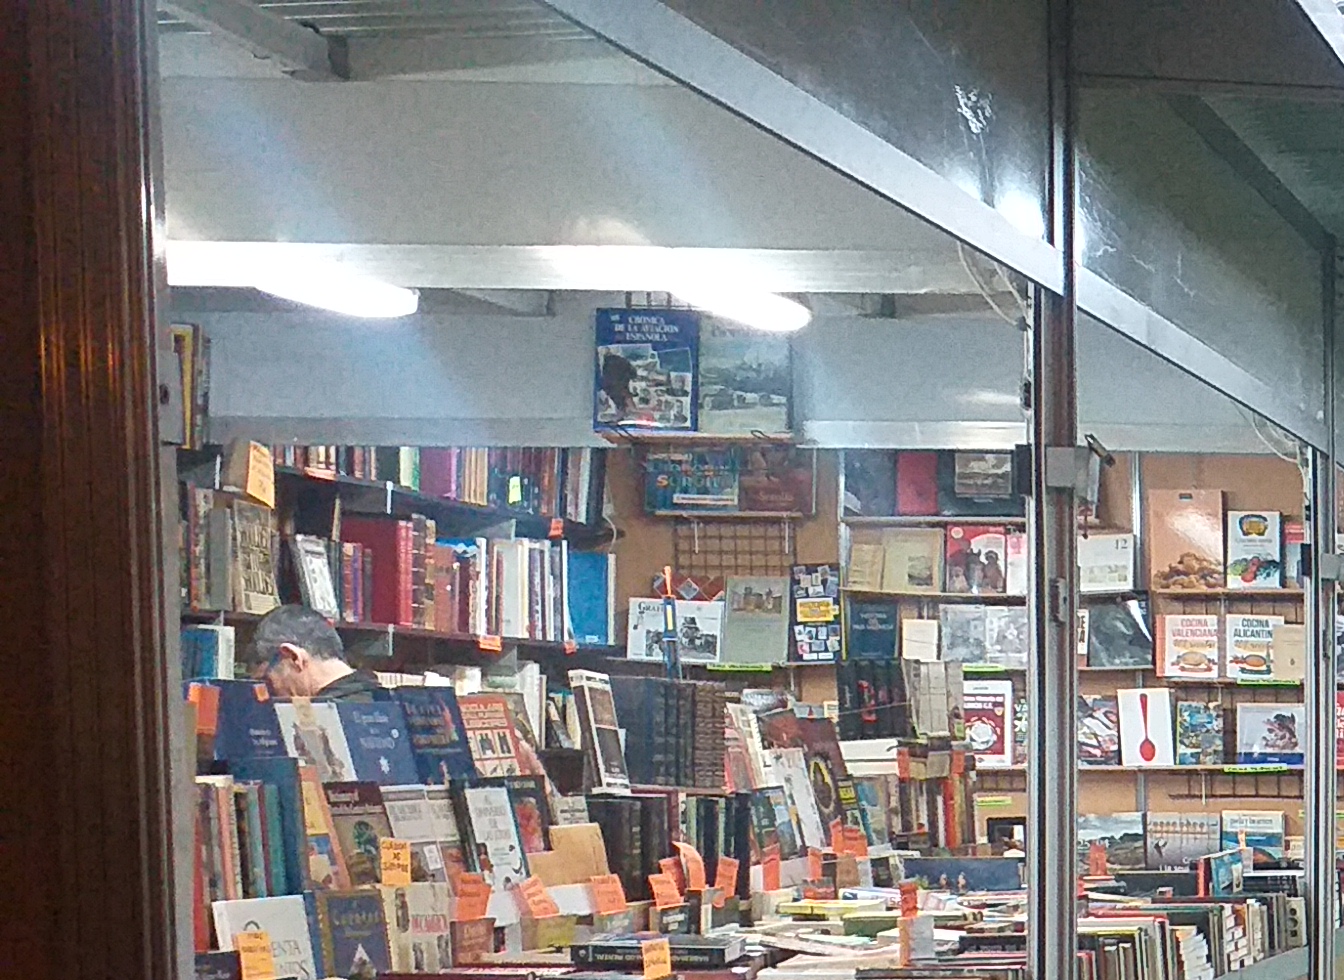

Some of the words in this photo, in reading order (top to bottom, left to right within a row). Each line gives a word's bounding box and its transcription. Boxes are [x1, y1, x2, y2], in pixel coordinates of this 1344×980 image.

[1180, 618, 1209, 628] COCINA
[1241, 617, 1270, 628] COCINA
[1233, 628, 1274, 639] ALICANTIN
